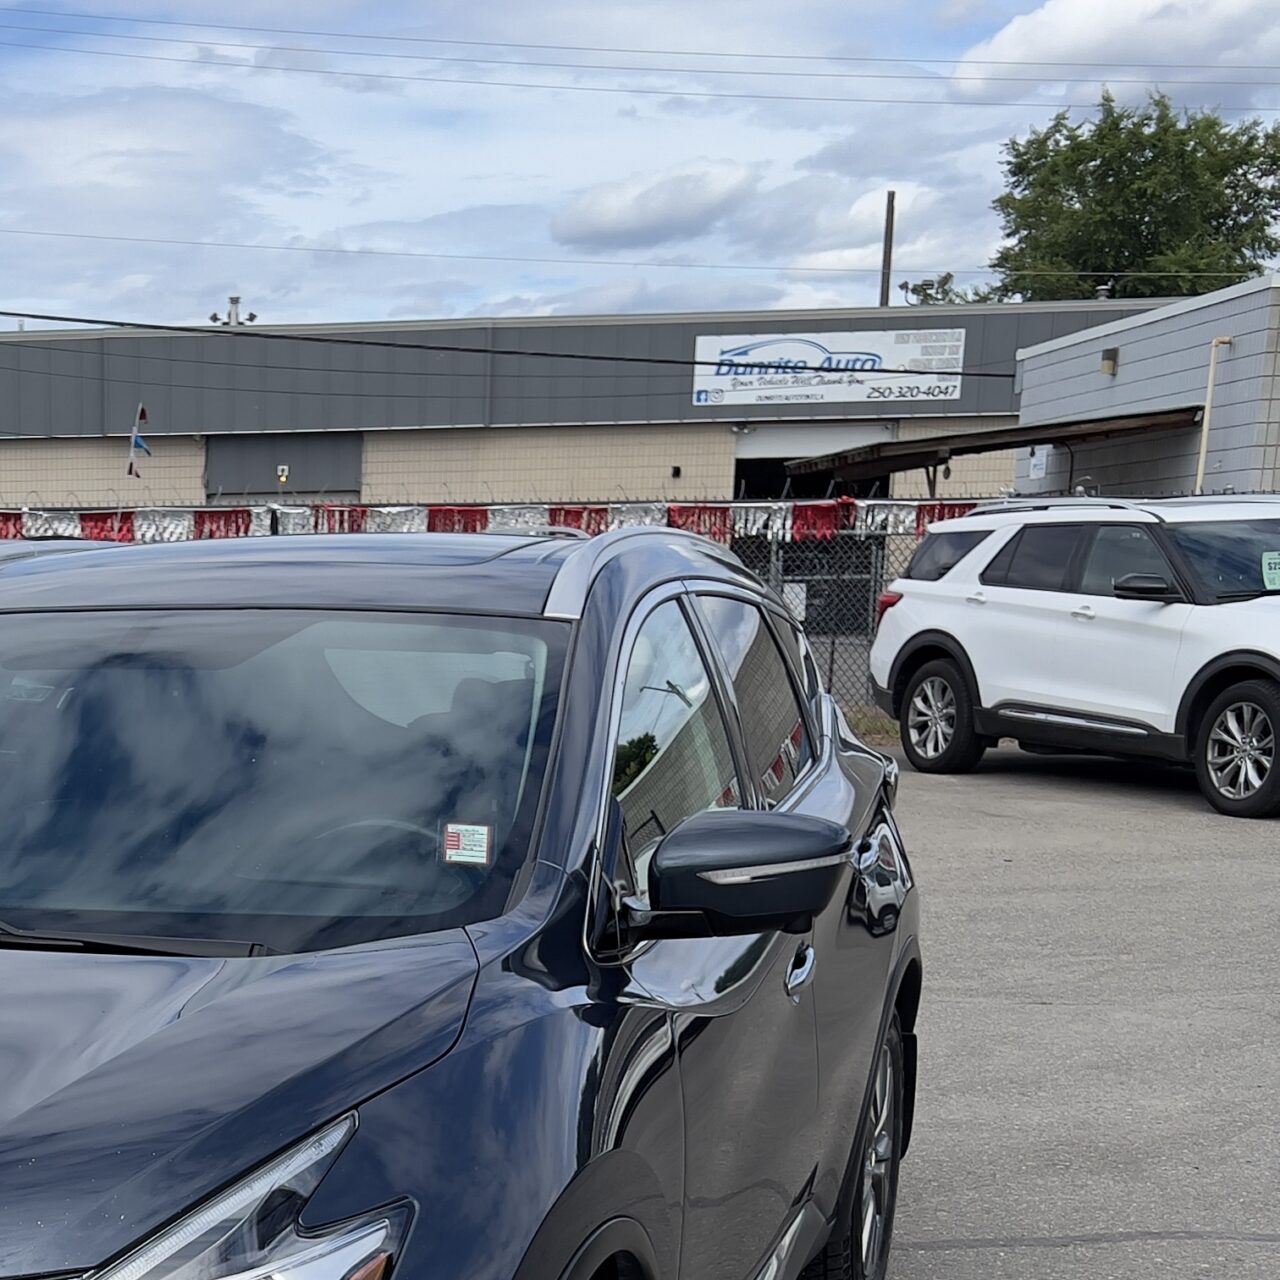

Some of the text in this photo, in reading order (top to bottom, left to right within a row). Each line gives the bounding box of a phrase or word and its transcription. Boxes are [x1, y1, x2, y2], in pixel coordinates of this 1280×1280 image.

[715, 356, 878, 376] Dunrite Auto
[730, 377, 754, 391] Your
[791, 375, 813, 386] Will
[813, 374, 844, 386] Thank
[846, 374, 865, 387] You
[866, 385, 958, 399] 250-320-4047
